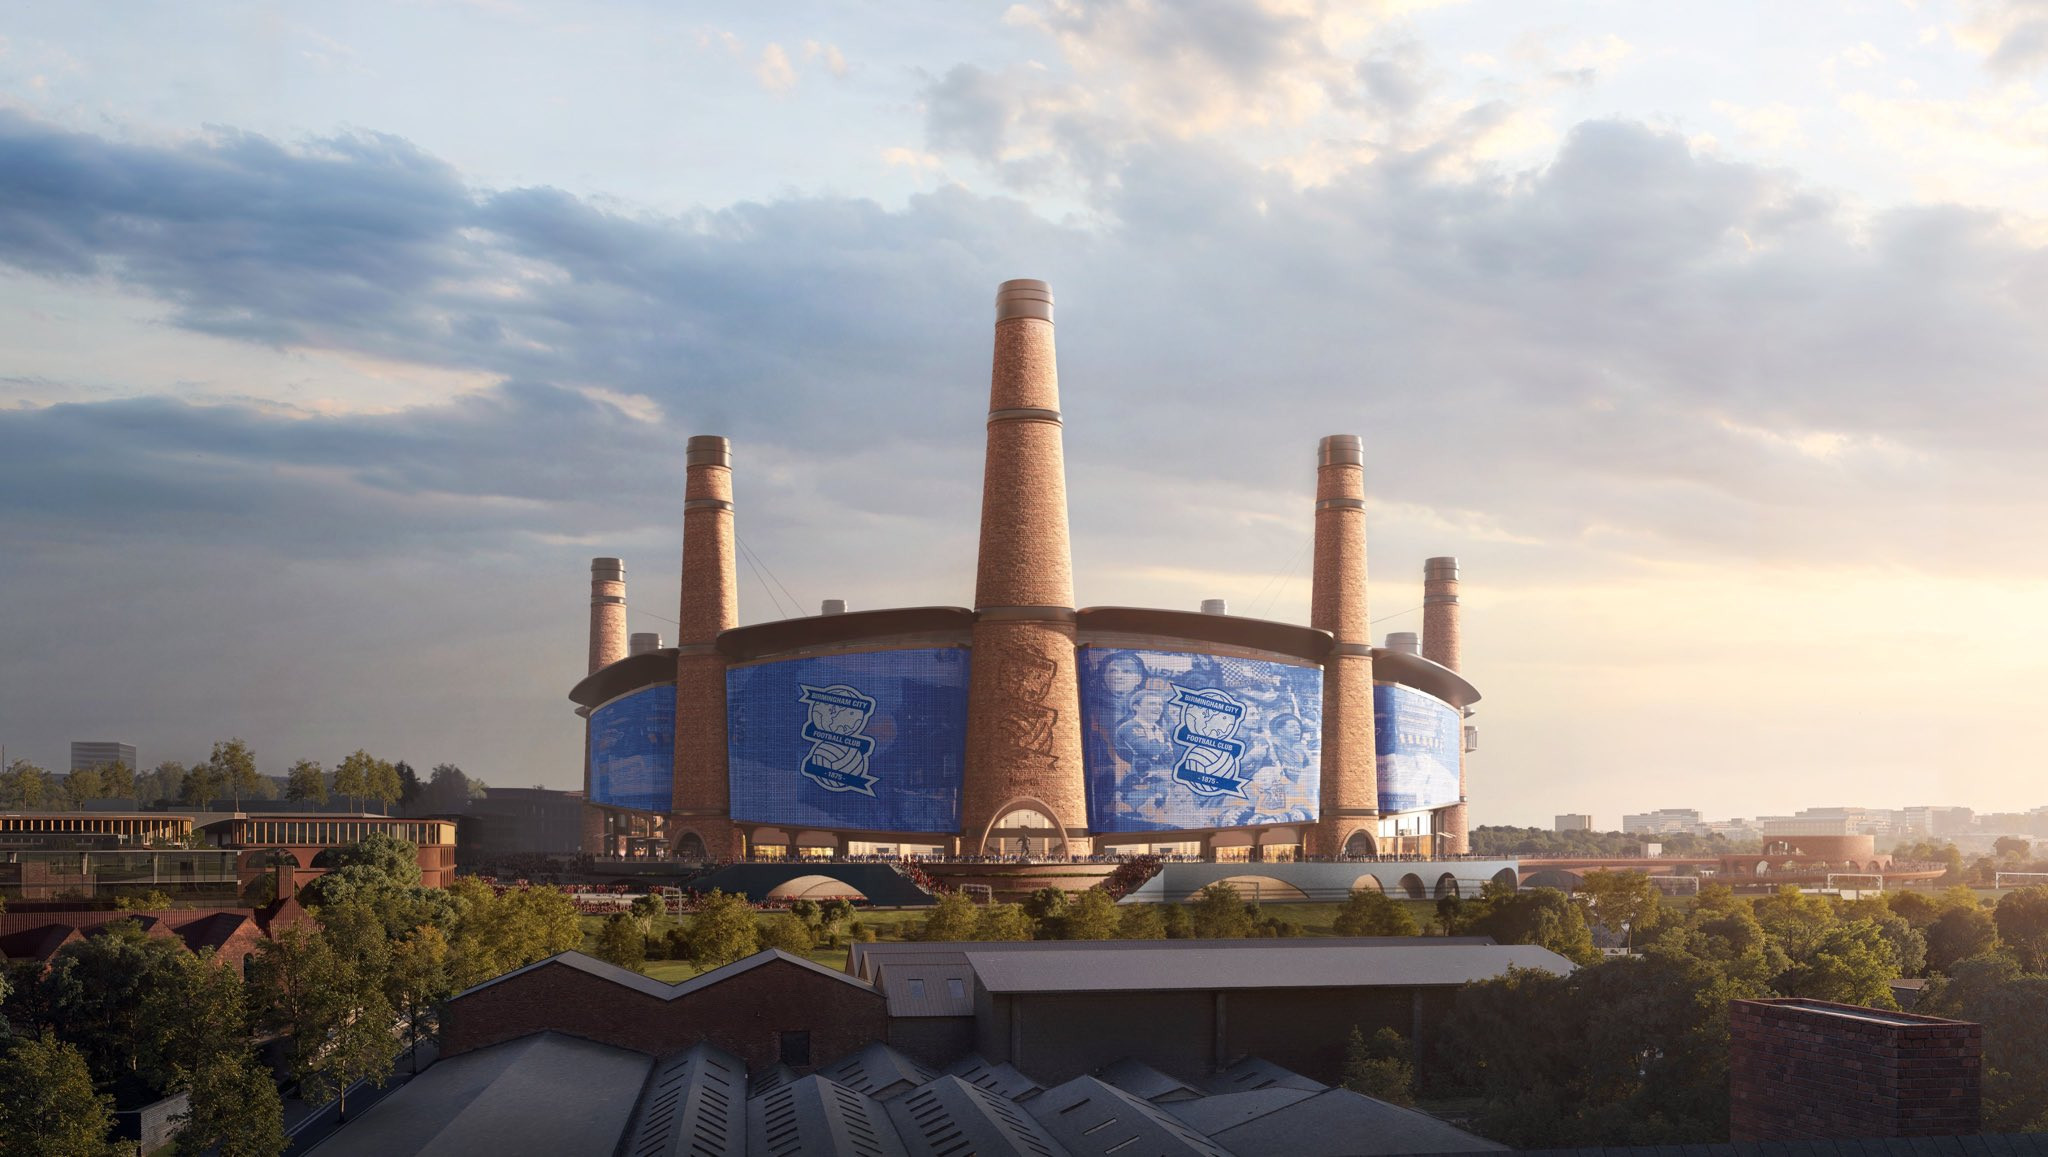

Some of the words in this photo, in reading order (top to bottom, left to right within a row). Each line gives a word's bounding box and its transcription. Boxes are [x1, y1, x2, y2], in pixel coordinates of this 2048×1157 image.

[811, 693, 852, 707] BIRMINGHAM
[852, 699, 868, 709] CITY
[1184, 694, 1224, 711] BIRMINGHAM
[1224, 704, 1239, 714] CITY
[813, 731, 844, 744] FOOTBALL
[844, 737, 861, 748] CLUB
[1186, 734, 1217, 747] FOOTBALL
[1217, 741, 1233, 751] CLUB
